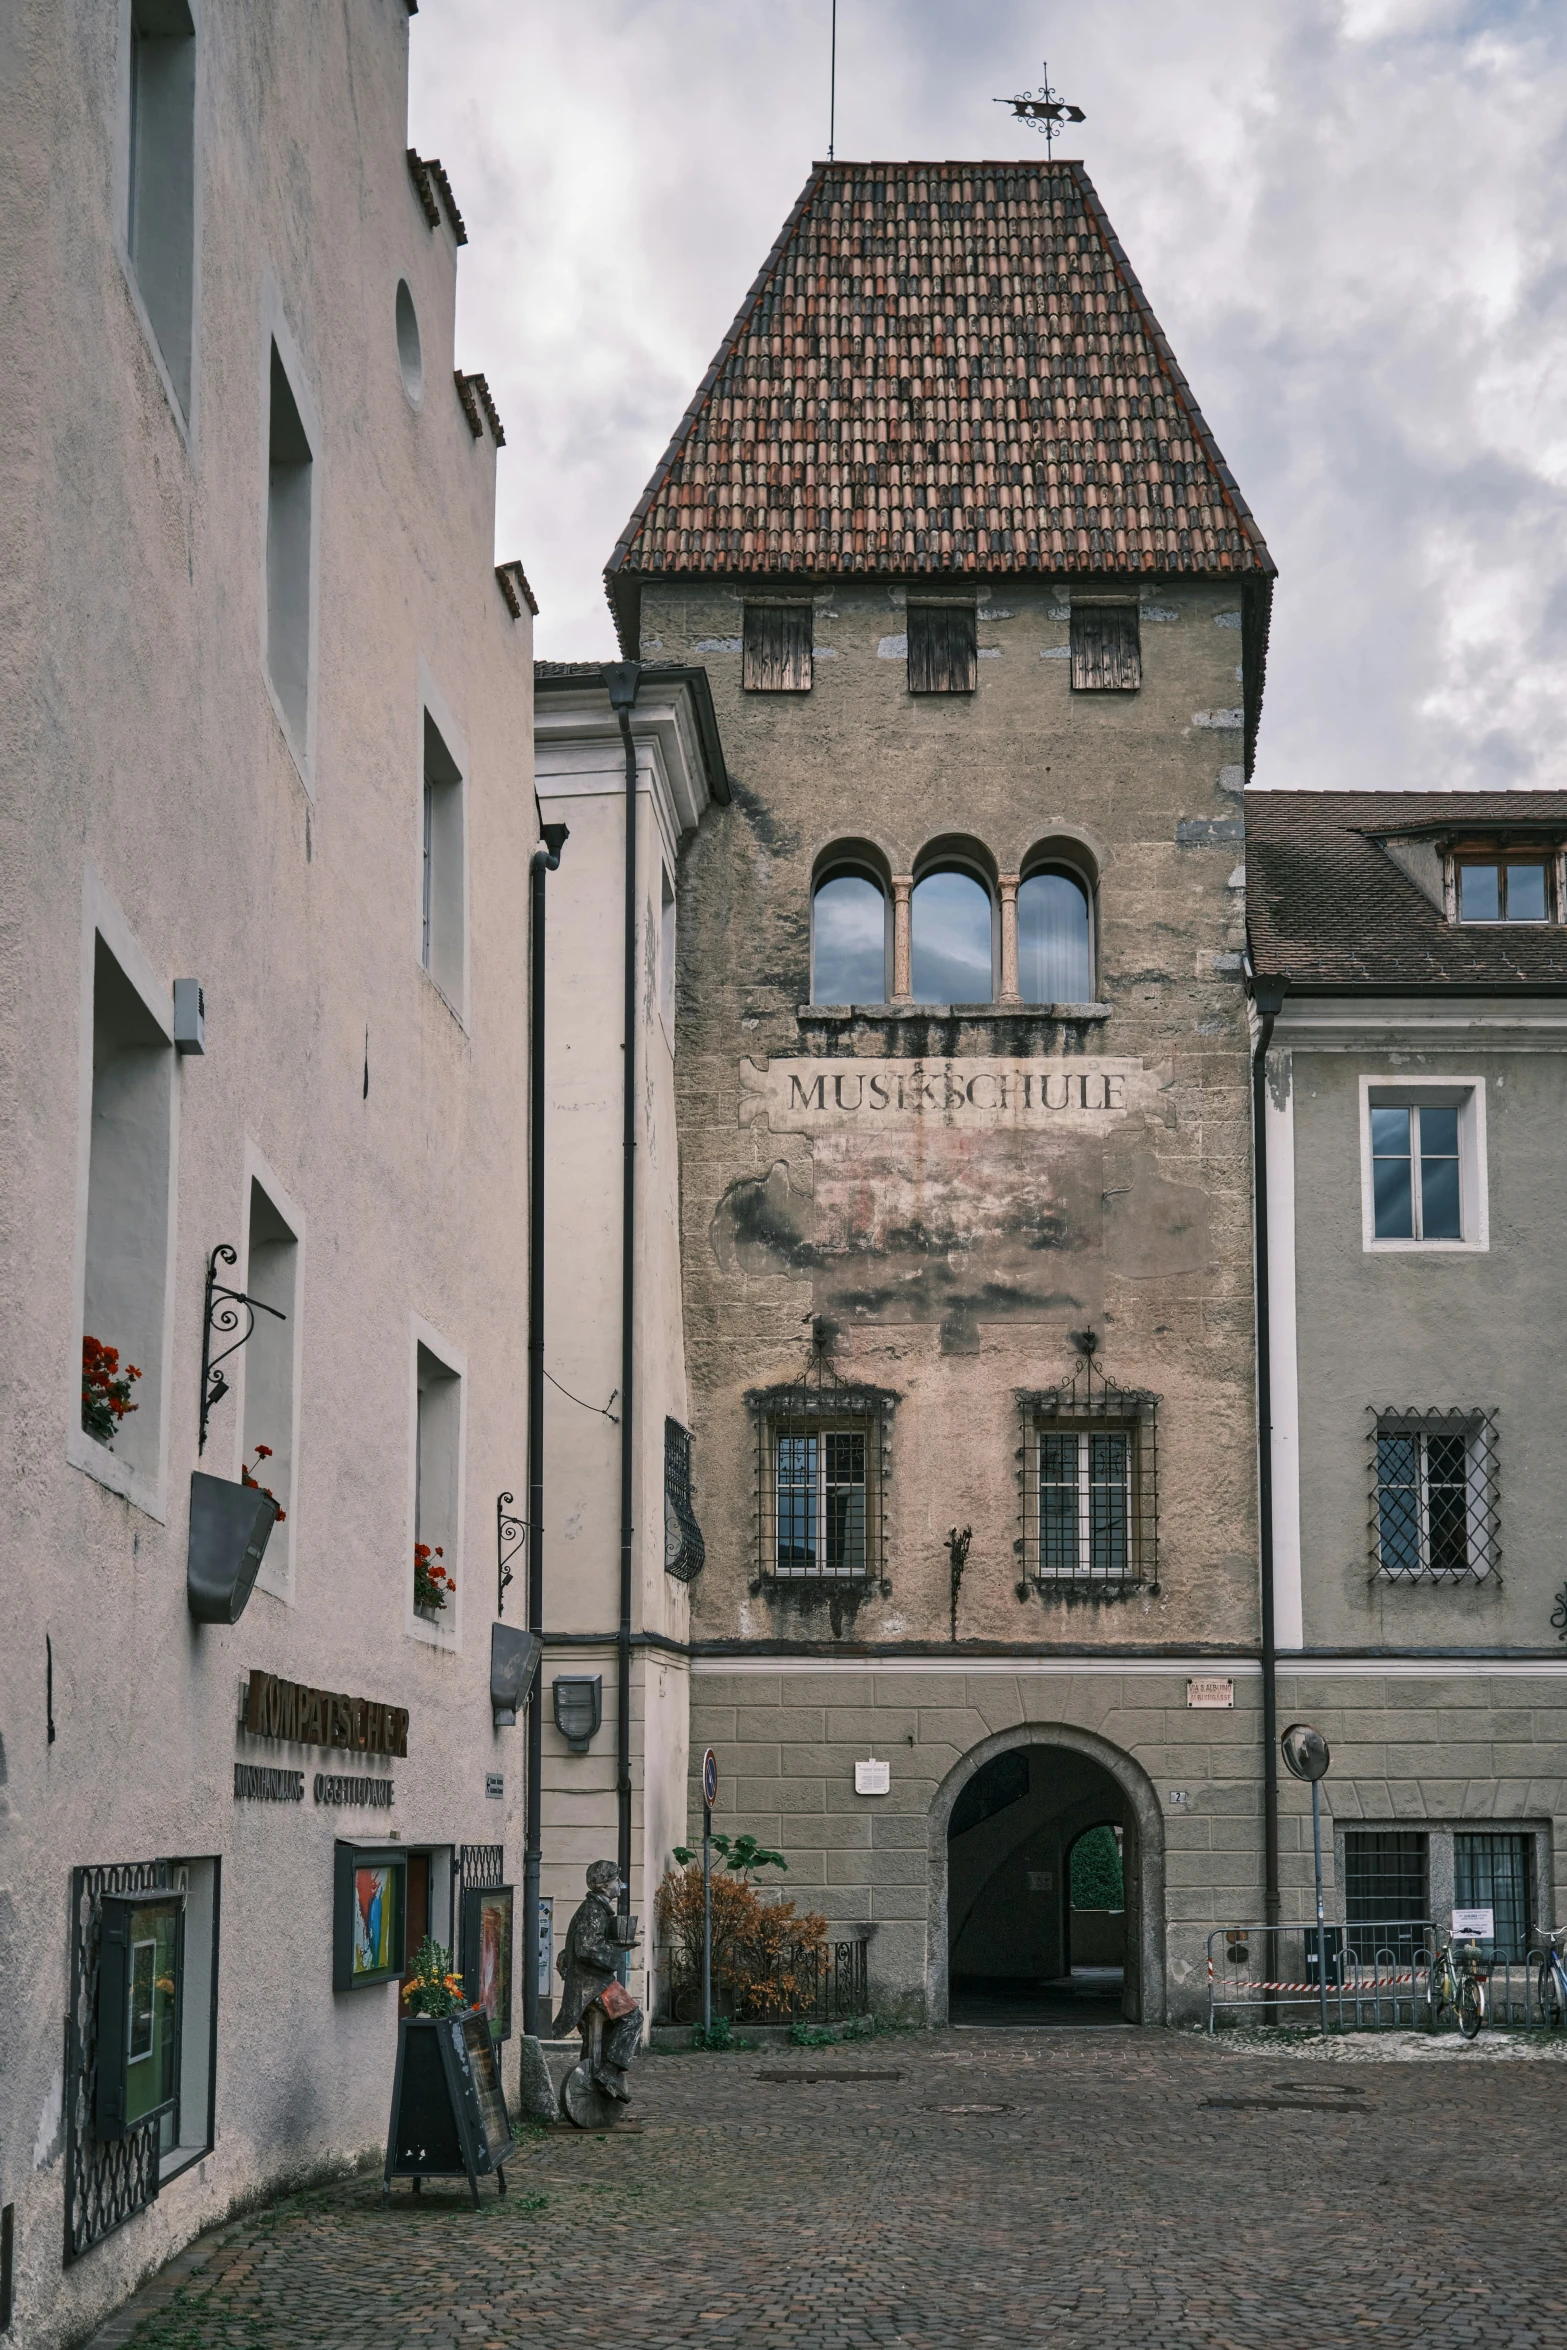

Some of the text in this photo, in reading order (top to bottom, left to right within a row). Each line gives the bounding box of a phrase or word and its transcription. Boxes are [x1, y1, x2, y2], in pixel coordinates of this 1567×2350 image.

[787, 1073, 1126, 1111] MUSIKSCHULE
[247, 1669, 409, 1758] KOMPATSCHER
[234, 1763, 304, 1800] KUNSTHANDLUNG
[1175, 1792, 1181, 1802] 2
